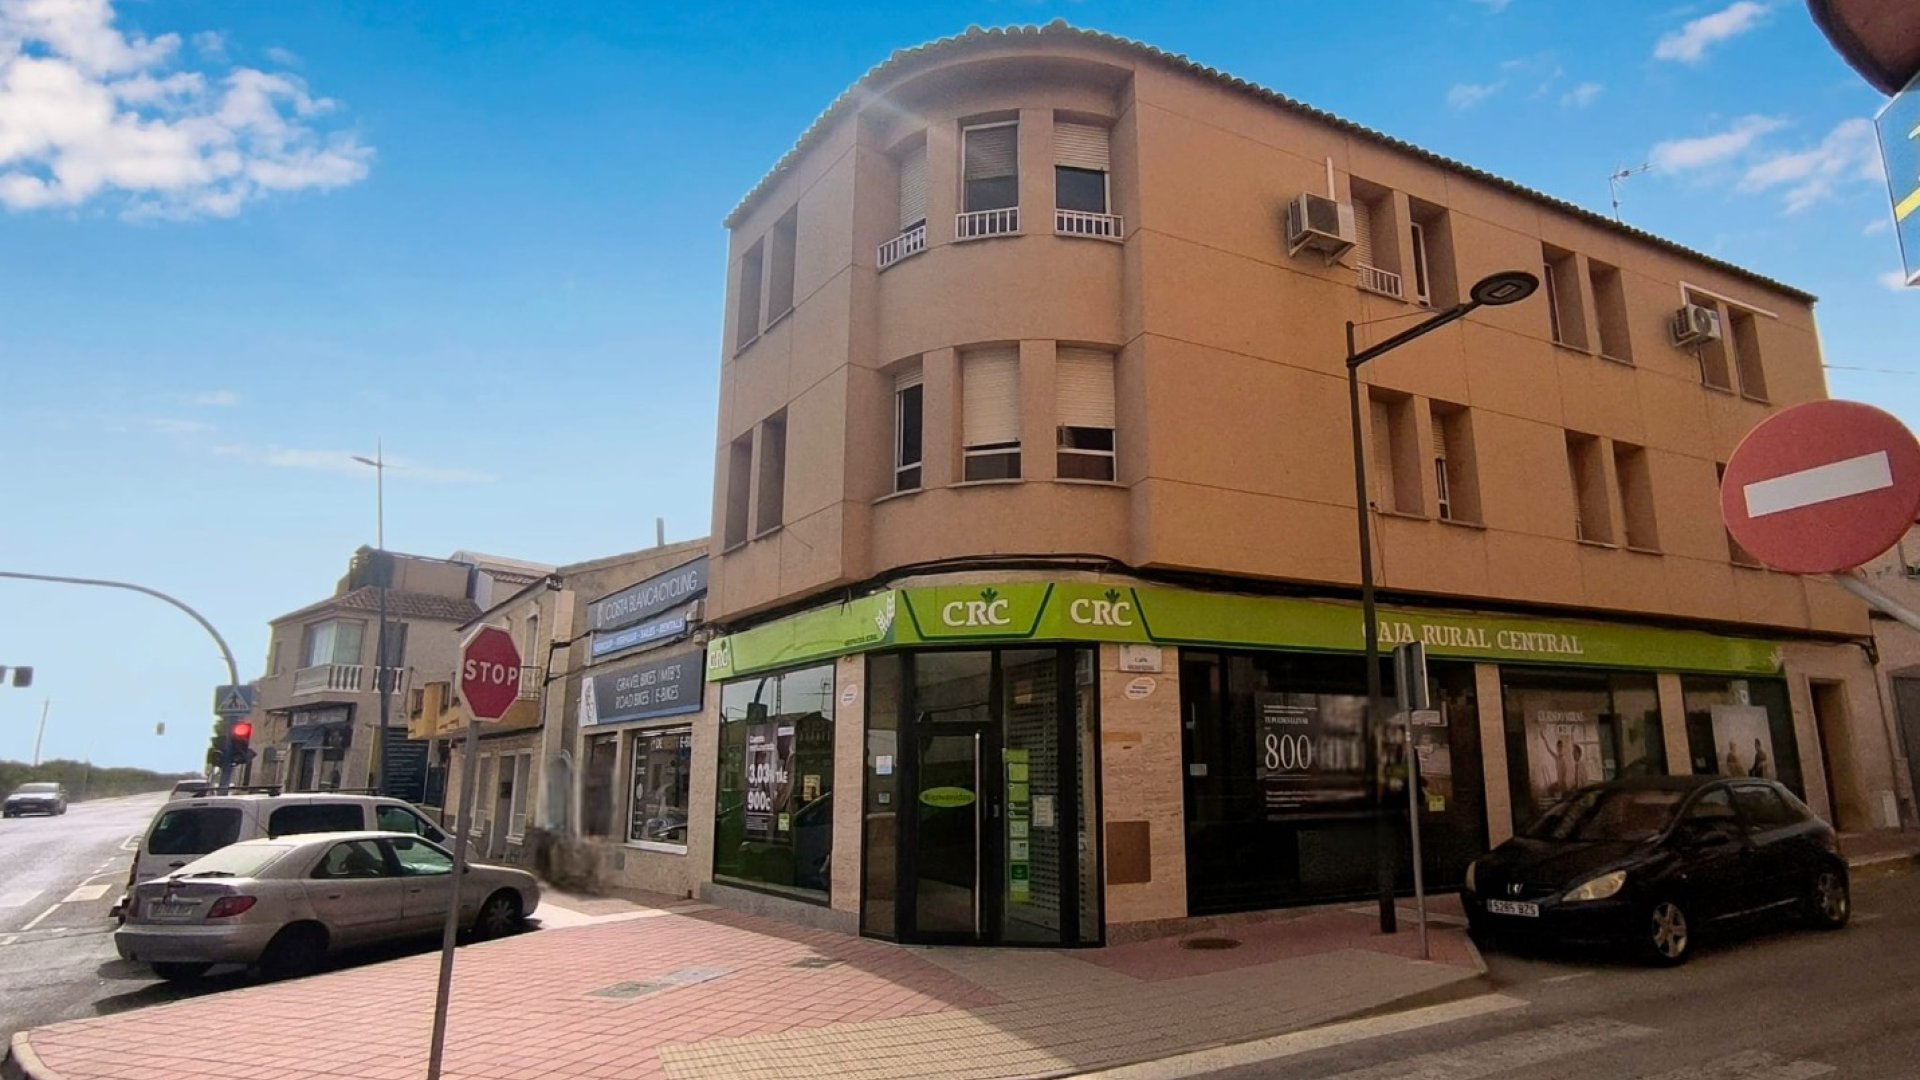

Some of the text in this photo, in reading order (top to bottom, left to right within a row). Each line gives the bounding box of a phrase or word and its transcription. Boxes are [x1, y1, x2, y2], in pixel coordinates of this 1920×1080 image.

[606, 570, 697, 621] COSTA BLANCA CYCLING
[942, 598, 1012, 628] CRC
[1070, 597, 1133, 627] CRC
[1362, 621, 1584, 654] AJA RURAL CENTRAL
[463, 658, 520, 685] STOP
[616, 674, 639, 692] GRAVEL
[640, 669, 657, 687] BIKES
[615, 693, 633, 710] ROAD
[633, 690, 650, 706] BIKES
[1265, 733, 1312, 770] 800
